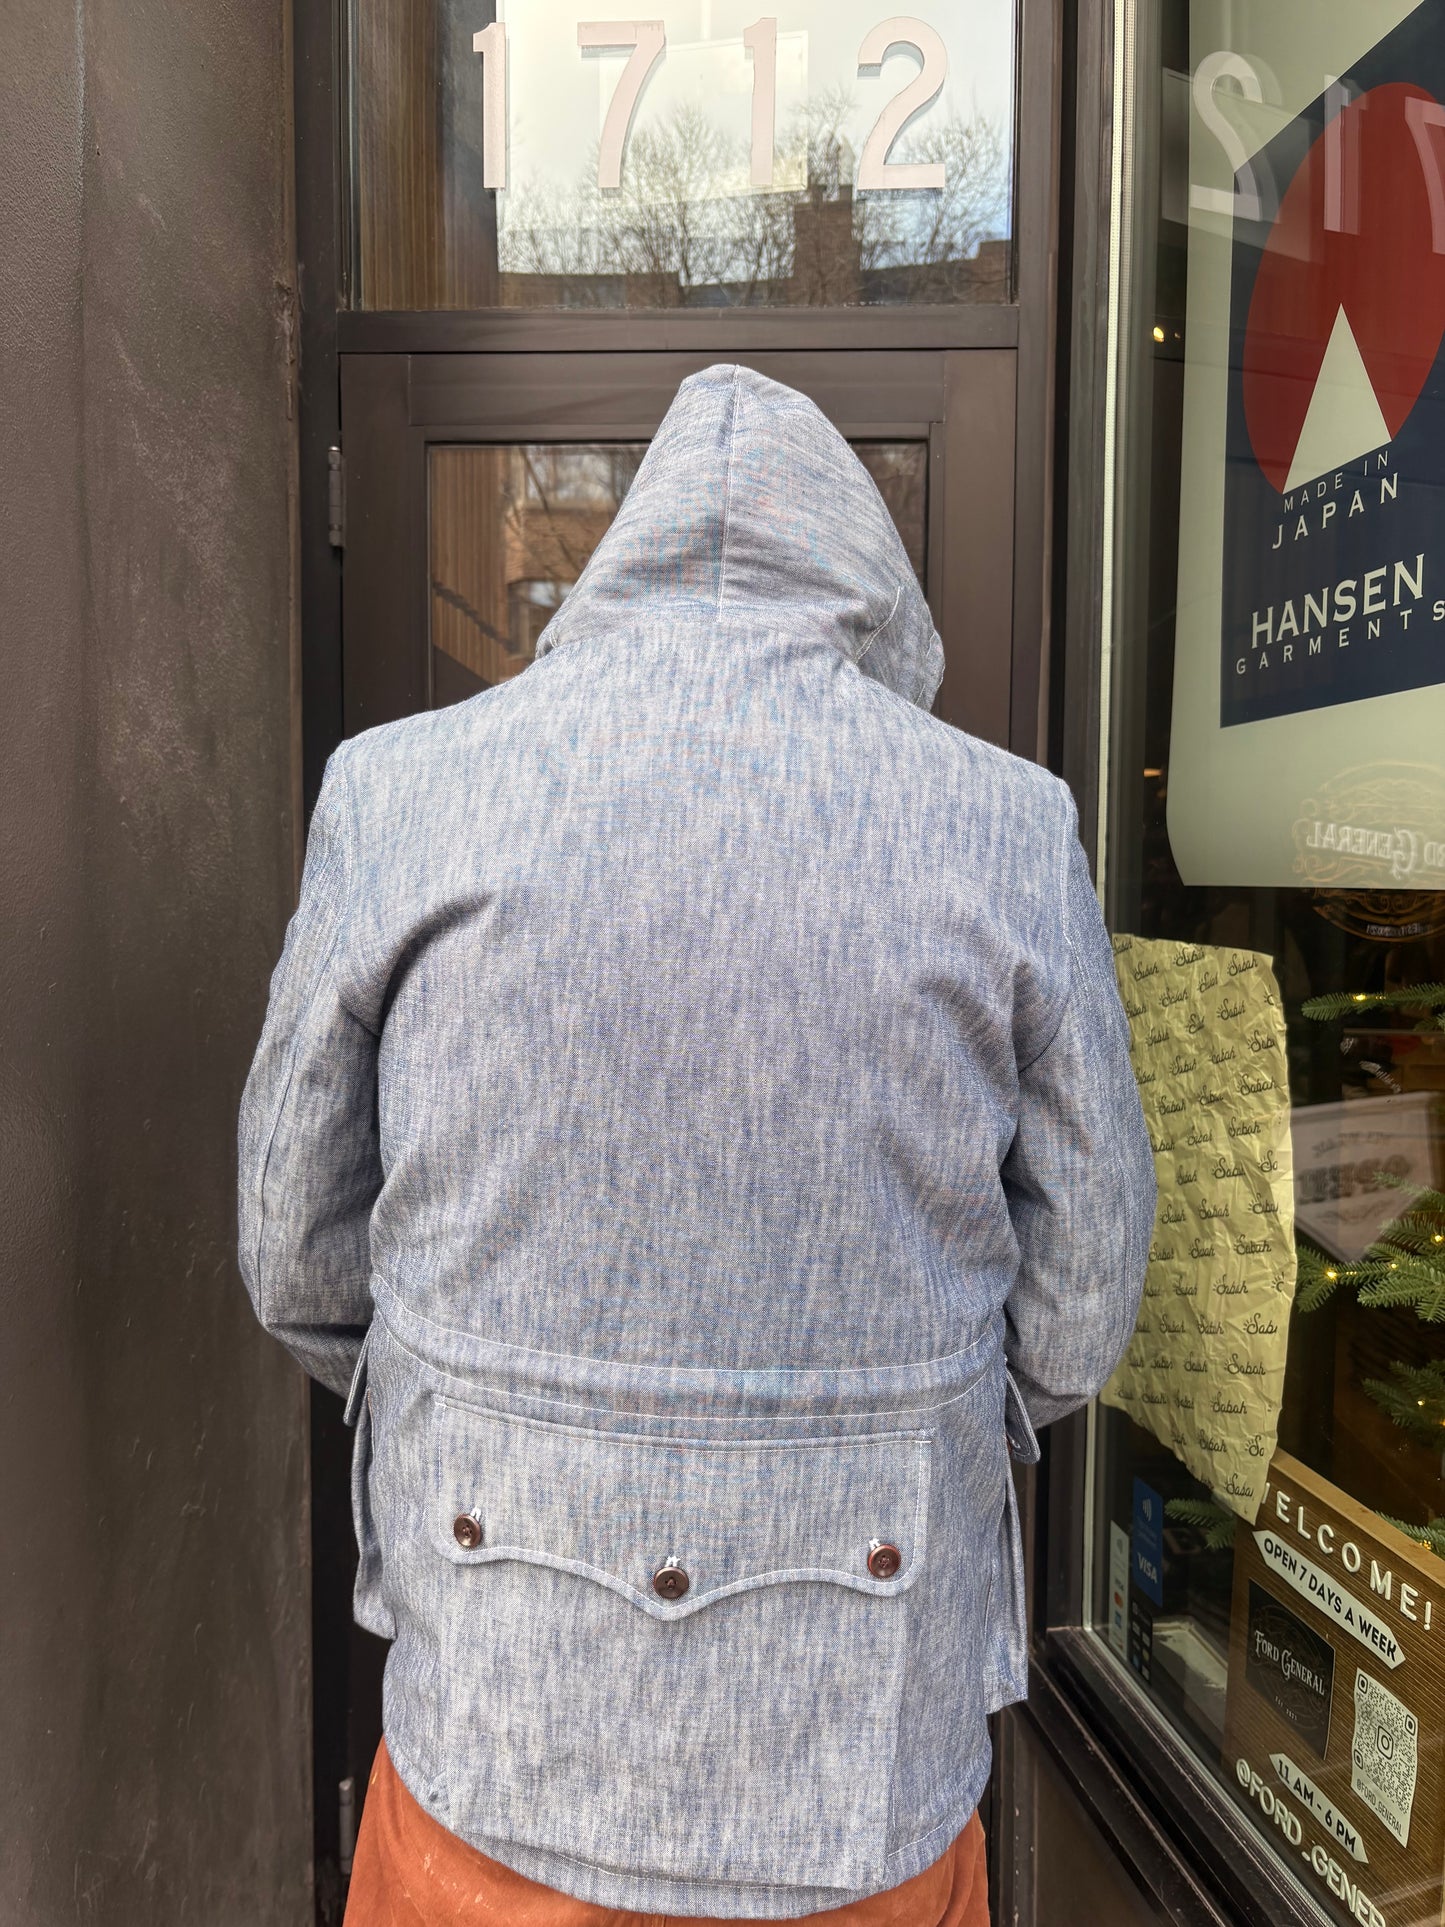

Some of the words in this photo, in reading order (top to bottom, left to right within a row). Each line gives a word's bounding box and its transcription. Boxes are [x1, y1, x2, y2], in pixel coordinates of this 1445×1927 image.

[473, 16, 948, 190] 1712
[1272, 472, 1398, 549] JAPAN
[1284, 472, 1343, 513] MADE
[1364, 451, 1388, 476] IN
[1252, 553, 1424, 649] HANSEN
[1236, 600, 1445, 674] GARMENTS
[1240, 1073, 1276, 1096] Sabah
[1229, 1117, 1261, 1138] Sabah
[1227, 1353, 1266, 1375] Sabah
[1212, 1391, 1247, 1415] Sabah
[1137, 1552, 1158, 1585] VISA
[1262, 1482, 1432, 1630] ELCOME!
[1264, 1538, 1297, 1575] OPEN
[1299, 1565, 1308, 1581] 7
[1308, 1574, 1342, 1614] DAYS
[1345, 1608, 1354, 1627] A
[1359, 1614, 1396, 1662] WEEK
[1254, 1629, 1279, 1662] FORD
[1281, 1649, 1324, 1696] GENERAL
[1278, 1759, 1290, 1783] 11
[1293, 1780, 1314, 1807] AM
[1325, 1809, 1333, 1827] 6
[1336, 1819, 1356, 1853] PM
[1356, 1778, 1402, 1837] @FORD_GENERAL
